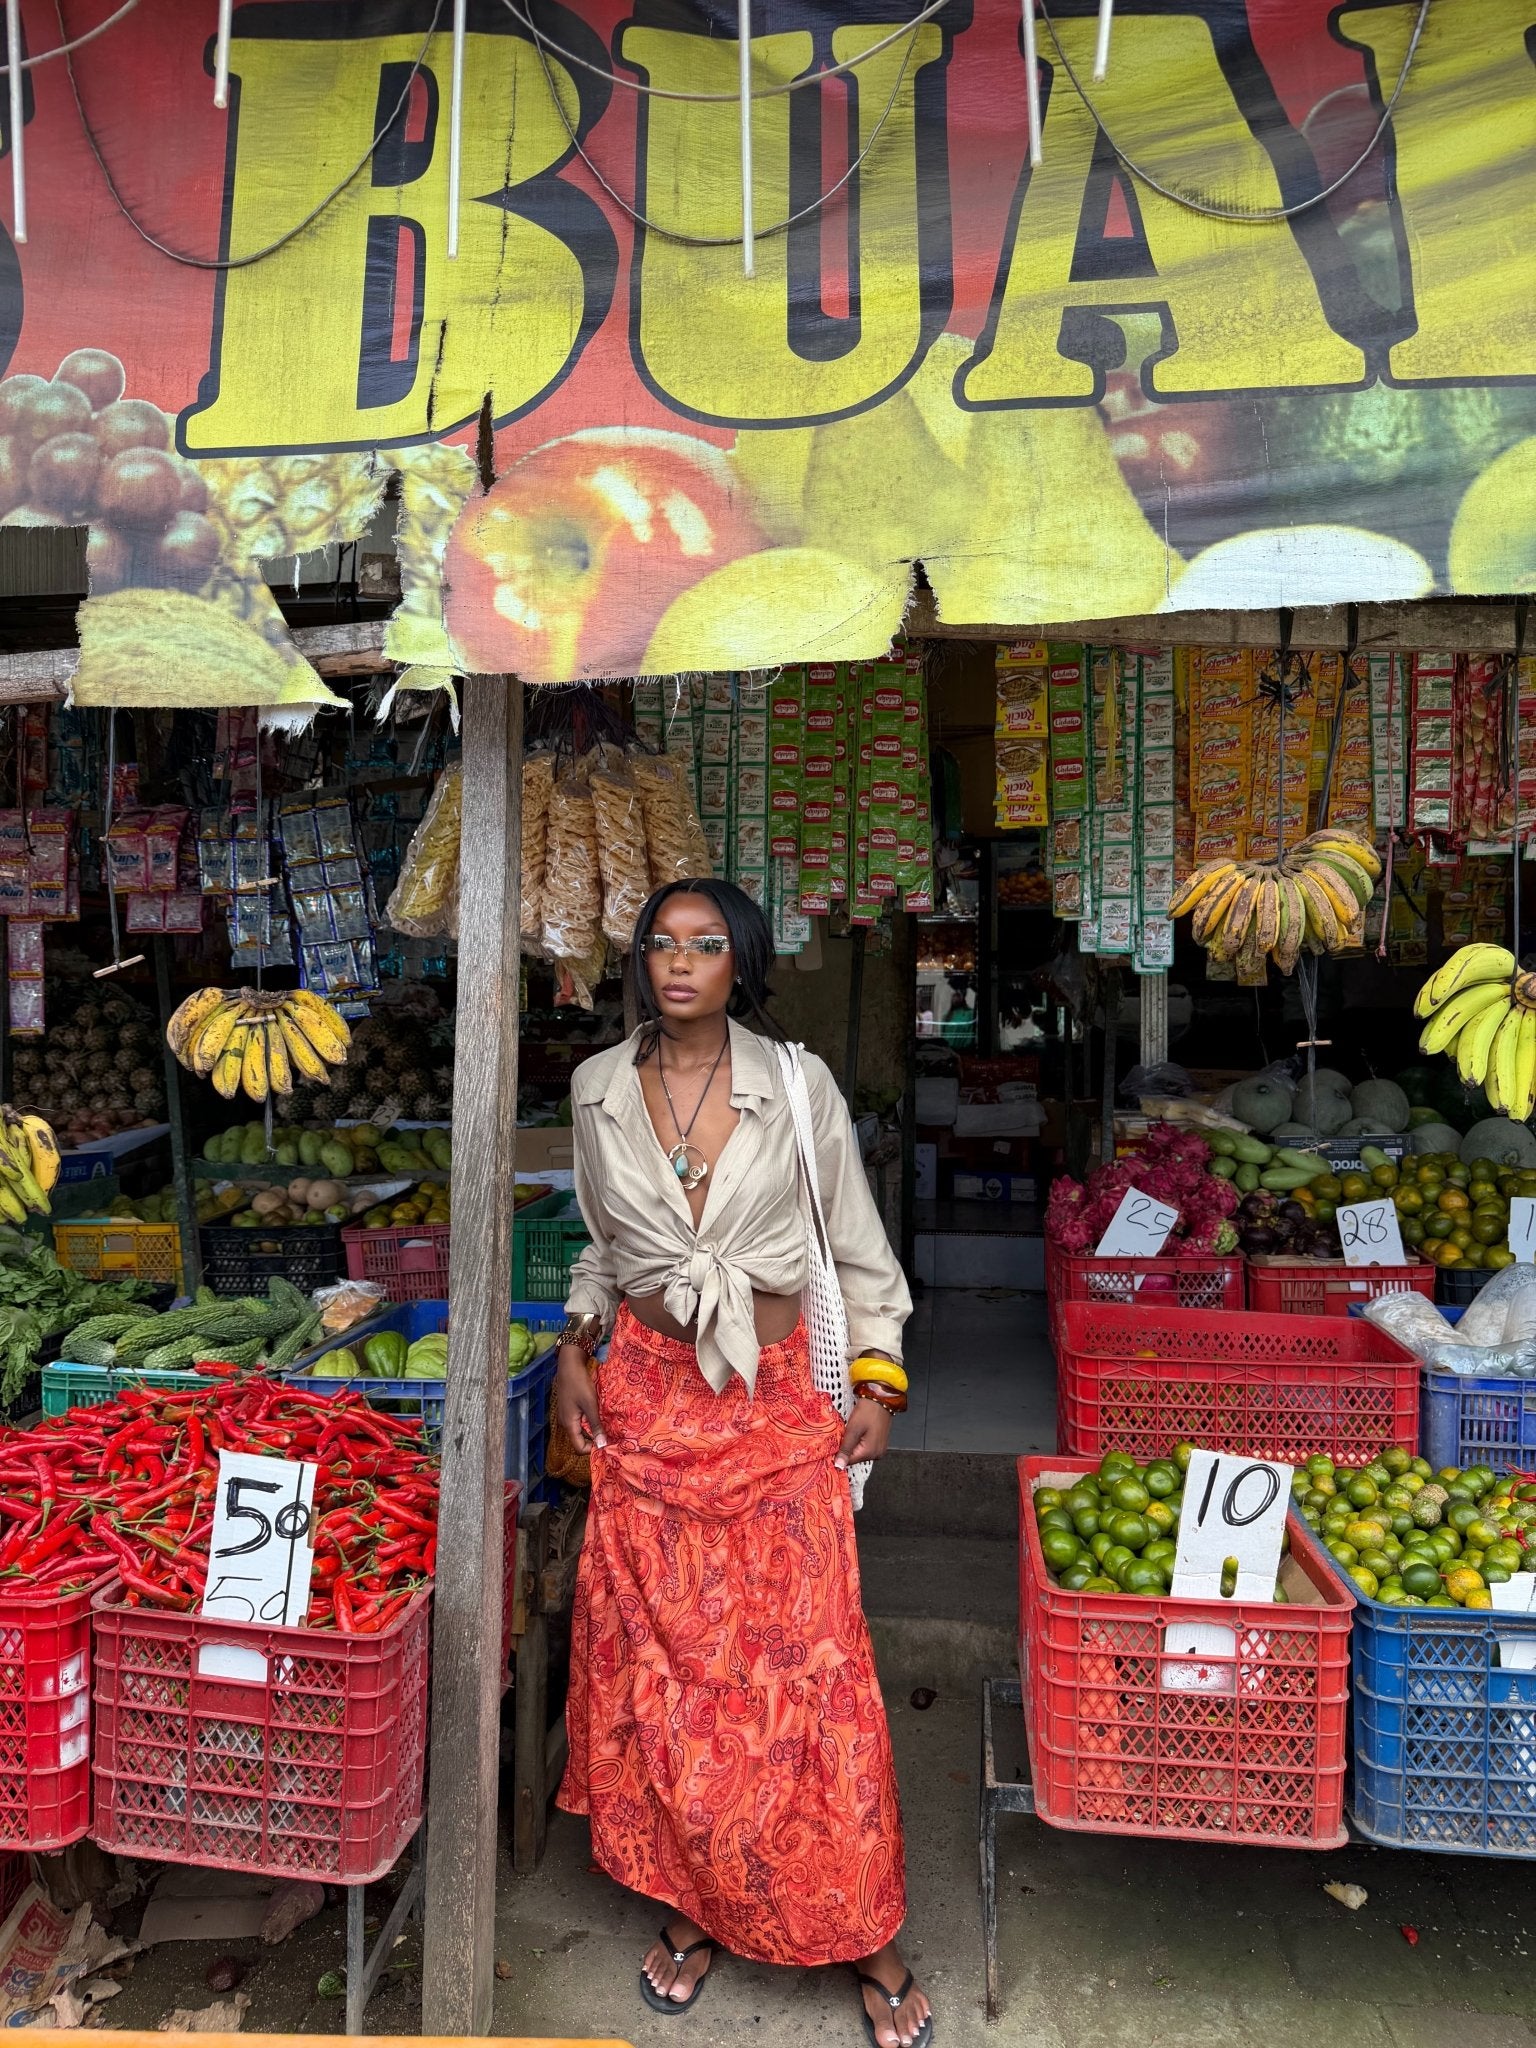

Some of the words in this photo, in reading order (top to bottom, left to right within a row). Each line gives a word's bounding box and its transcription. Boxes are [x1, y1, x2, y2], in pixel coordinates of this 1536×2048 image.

[1206, 655, 1242, 669] Masako
[1205, 696, 1241, 710] Masako
[1005, 709, 1035, 723] Racik
[1205, 739, 1240, 753] Masako
[806, 762, 831, 771] Ladaku
[1003, 780, 1034, 794] Racik
[1203, 781, 1240, 795] Masako
[1211, 806, 1246, 823] Masako
[1200, 838, 1237, 851] Masako
[372, 1107, 395, 1126] 23
[1126, 1198, 1174, 1236] 25
[1342, 1207, 1388, 1247] 28
[1198, 1458, 1281, 1527] 10
[215, 1477, 309, 1558] 50
